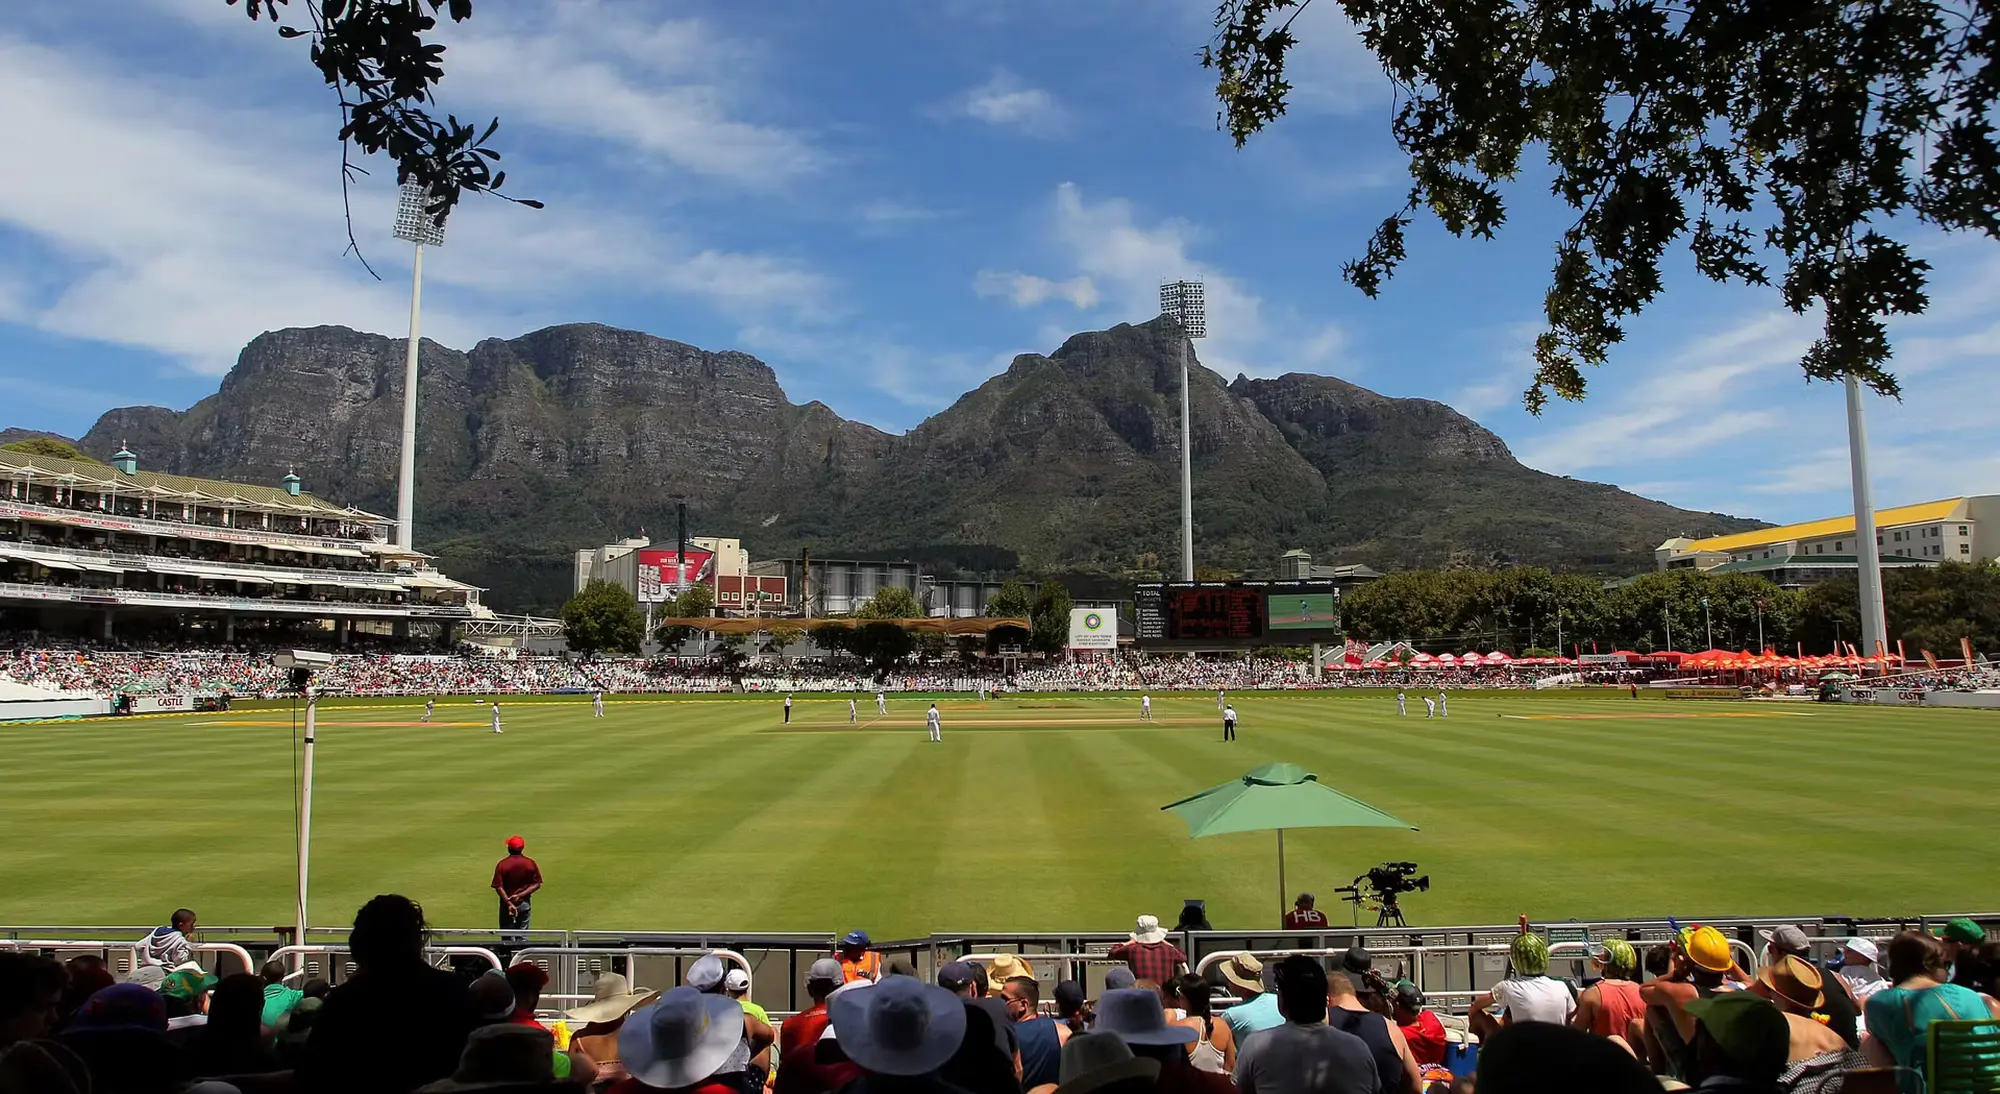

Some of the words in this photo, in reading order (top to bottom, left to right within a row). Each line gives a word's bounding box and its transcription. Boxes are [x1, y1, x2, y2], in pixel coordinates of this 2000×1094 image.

[1898, 692, 1925, 700] CAST
[157, 698, 184, 707] CASTLE
[1293, 910, 1321, 924] HB
